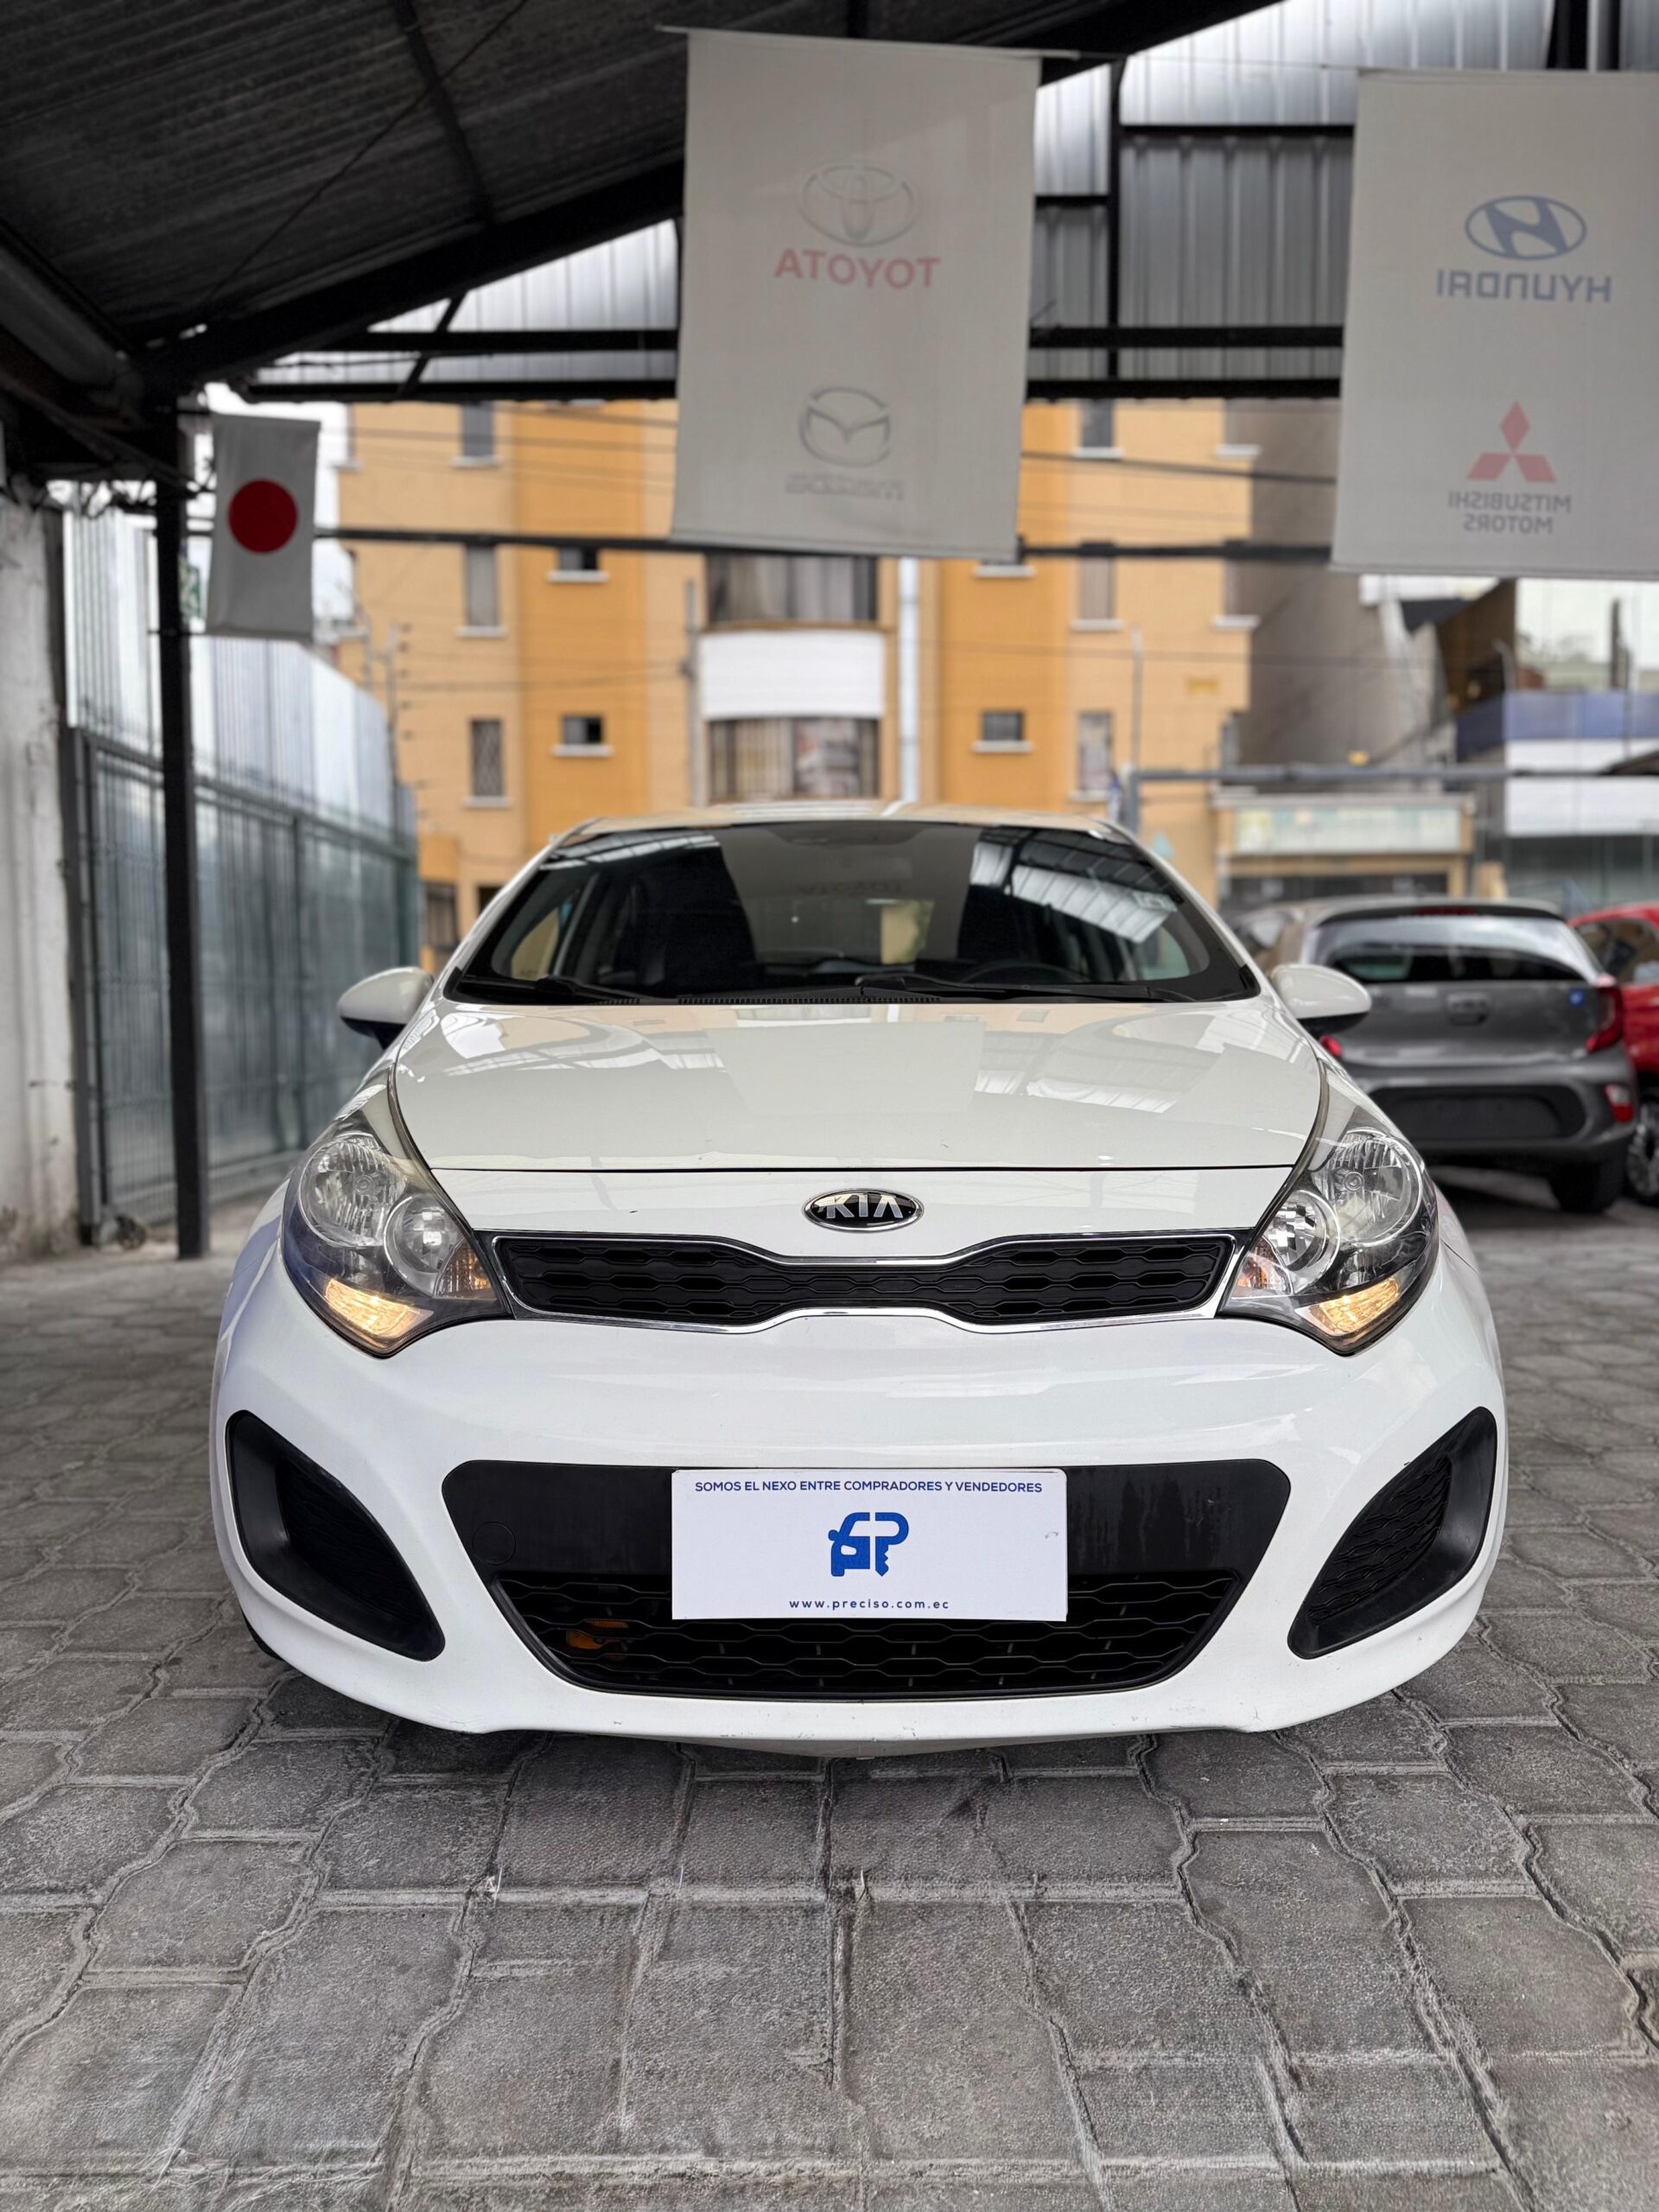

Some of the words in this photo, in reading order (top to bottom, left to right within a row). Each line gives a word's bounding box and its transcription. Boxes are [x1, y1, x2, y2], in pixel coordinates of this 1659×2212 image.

[821, 1193, 904, 1219] KIA
[695, 1481, 741, 1492] SOMOS
[744, 1481, 760, 1491] EL
[762, 1480, 797, 1491] NEXO
[799, 1480, 842, 1491] ENTRE
[843, 1480, 943, 1492] COMPRADORES
[944, 1481, 954, 1491] Y
[955, 1481, 1043, 1493] VENDEDORES
[788, 1598, 950, 1611] www.preciso.com.ec
